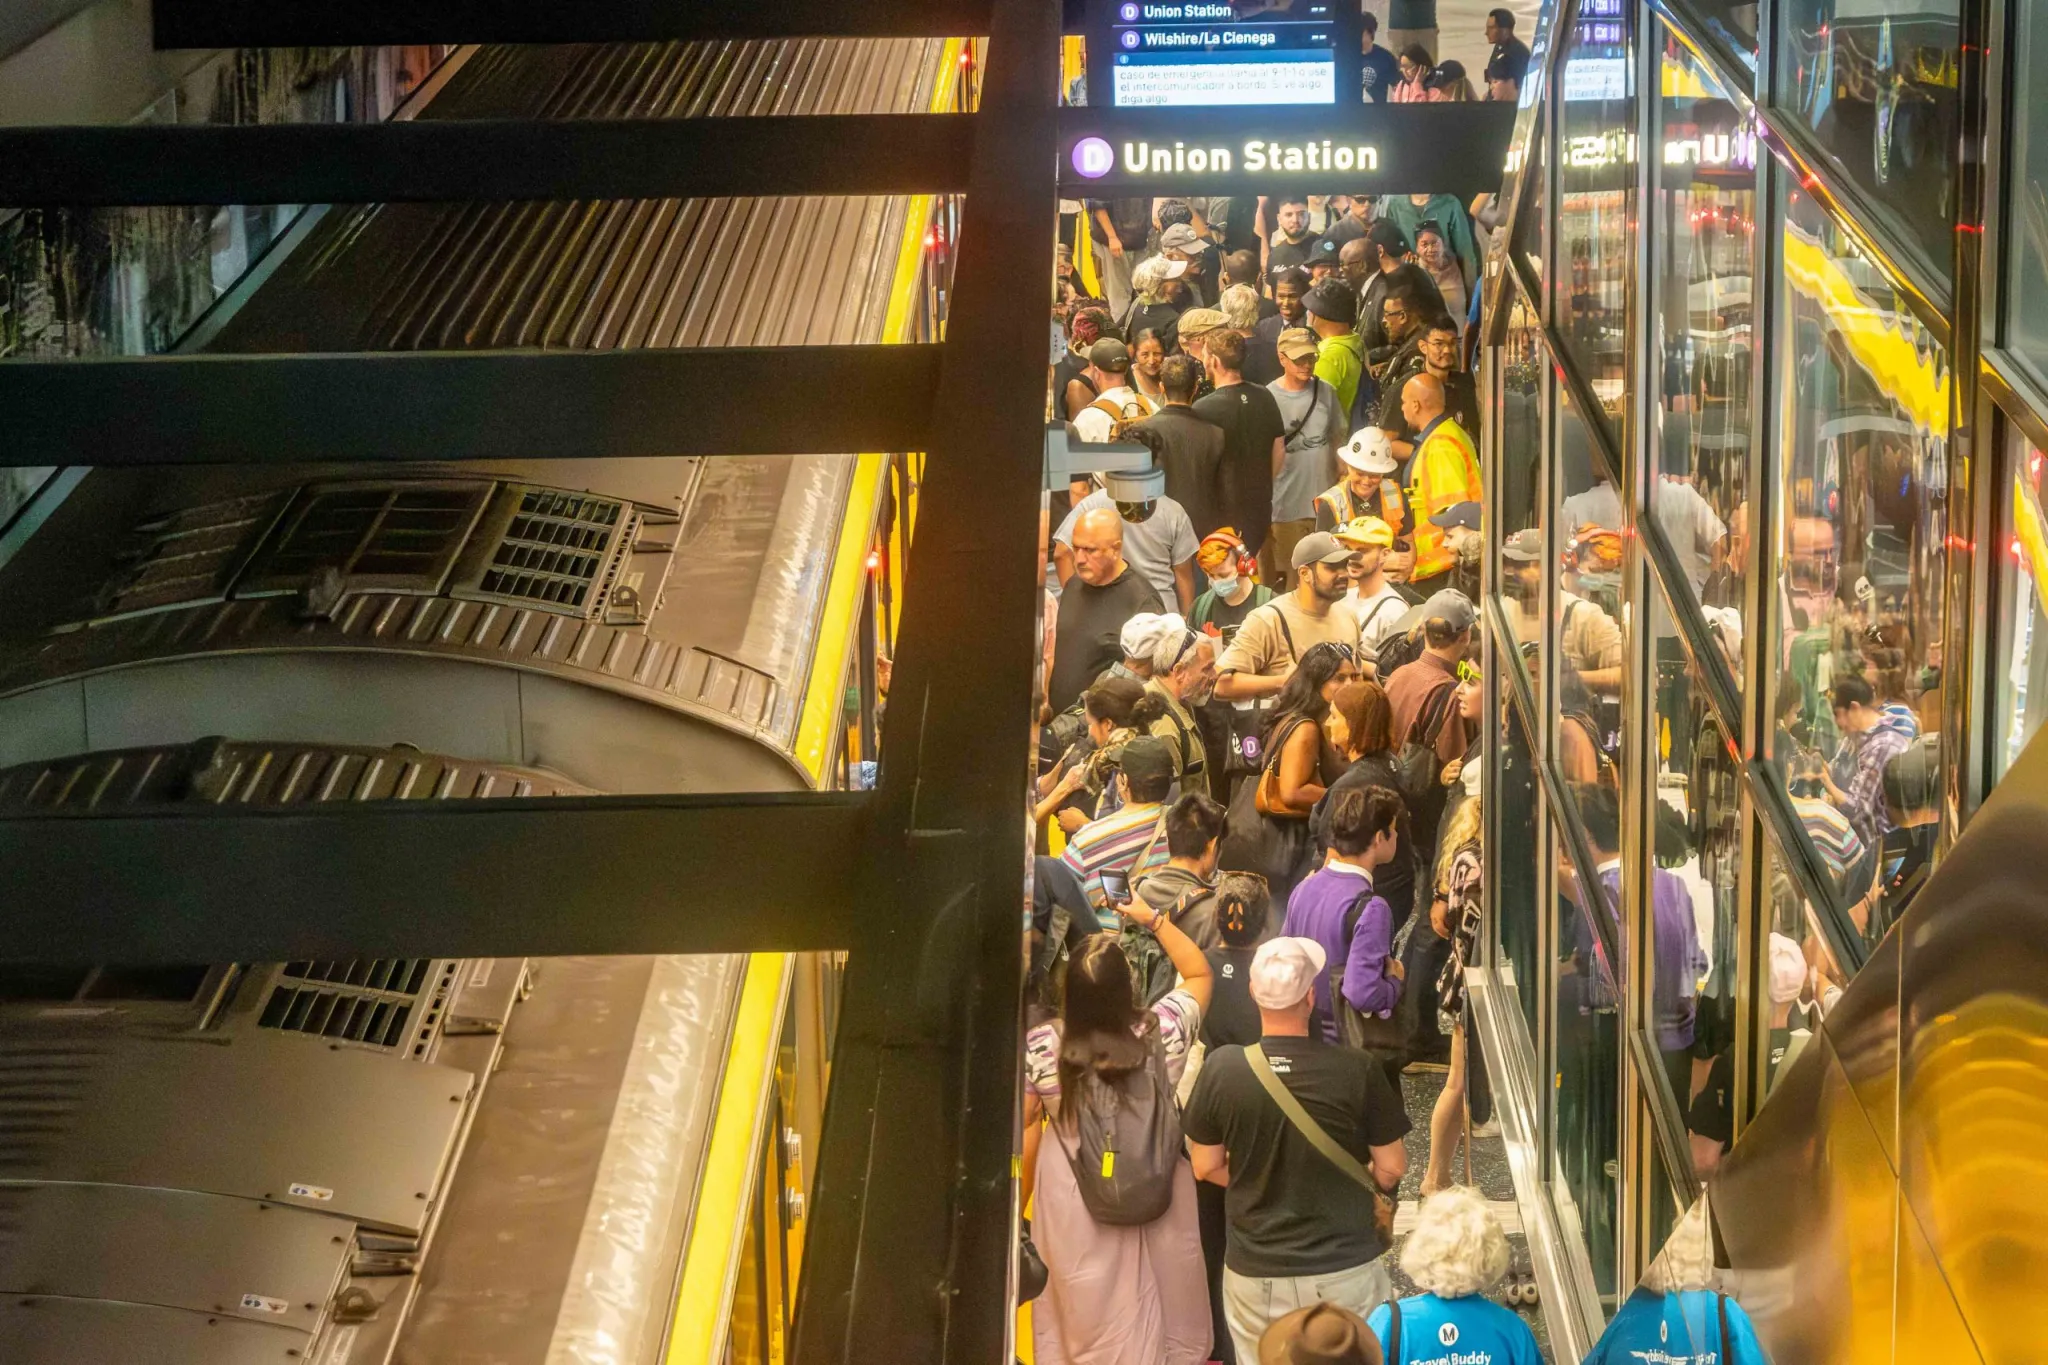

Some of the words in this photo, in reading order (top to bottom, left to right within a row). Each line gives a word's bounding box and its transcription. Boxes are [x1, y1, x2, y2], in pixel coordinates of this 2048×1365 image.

[1144, 5, 1181, 18] Union
[1184, 4, 1232, 17] Station
[1145, 31, 1220, 45] Wilshire/La
[1222, 31, 1276, 46] Cienega
[1120, 71, 1145, 80] caso
[1120, 82, 1130, 91] el
[1083, 143, 1106, 172] D
[1124, 141, 1231, 173] Union
[1243, 140, 1378, 171] Station
[1451, 1350, 1491, 1365] Buddy
